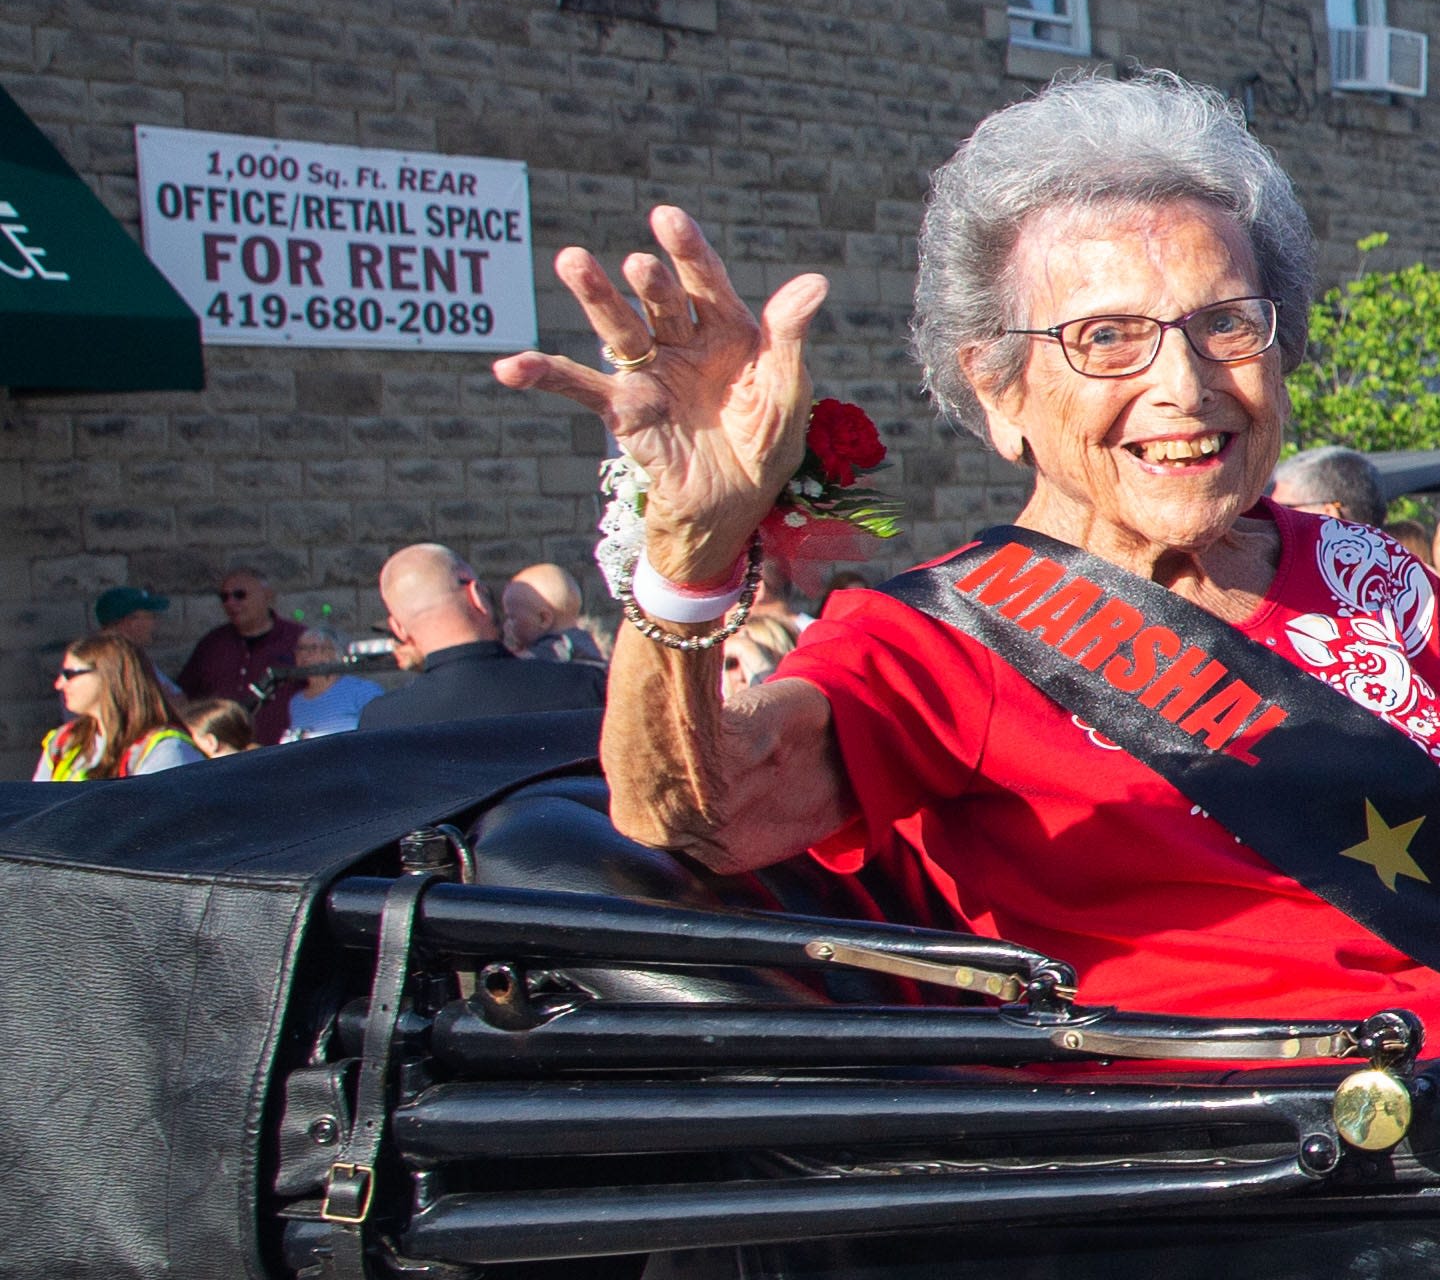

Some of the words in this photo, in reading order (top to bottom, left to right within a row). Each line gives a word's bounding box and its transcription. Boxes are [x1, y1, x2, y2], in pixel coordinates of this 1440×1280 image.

[207, 151, 300, 183] 1,000
[307, 163, 348, 190] Sq.
[357, 168, 388, 190] Ft.
[399, 169, 477, 197] REAR
[157, 182, 416, 235] OFFICE/RETAIL
[425, 205, 523, 243] SPACE
[203, 234, 325, 287] FOR
[349, 243, 490, 295] RENT
[207, 293, 494, 336] 419-680-2089
[954, 542, 1289, 767] MARSHAL
